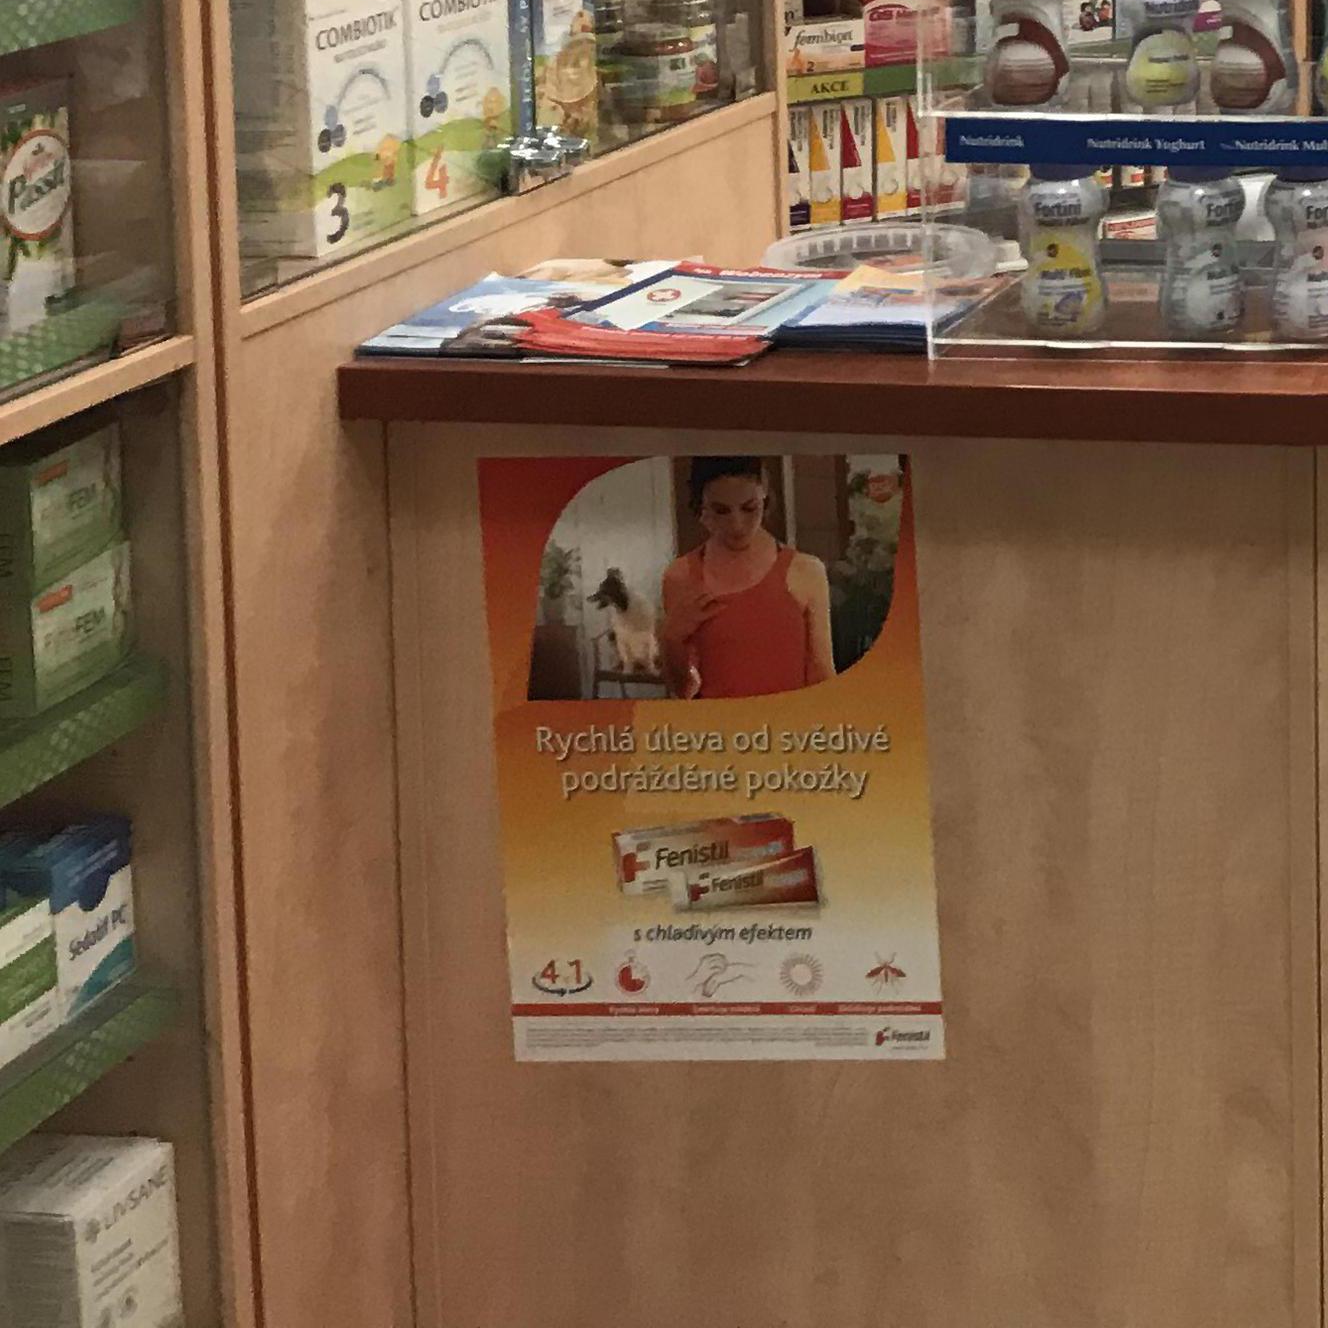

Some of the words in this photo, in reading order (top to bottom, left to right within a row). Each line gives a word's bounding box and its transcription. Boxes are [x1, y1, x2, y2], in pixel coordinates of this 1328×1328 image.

[960, 135, 1024, 148] Nutridrink
[1087, 138, 1152, 150] Nutridrink
[1155, 138, 1205, 153] Yoghurt
[1235, 140, 1299, 152] Nutridrink
[425, 144, 449, 198] 4
[327, 182, 349, 243] 3
[537, 725, 635, 760] Rychlá
[647, 724, 724, 752] úleva
[734, 726, 769, 752] od
[780, 724, 889, 752] svědivé
[562, 766, 736, 799] podrážděné
[746, 766, 867, 799] pokožky
[656, 840, 729, 870] Fenistil
[647, 924, 734, 944] chladivým
[740, 925, 812, 943] efektem
